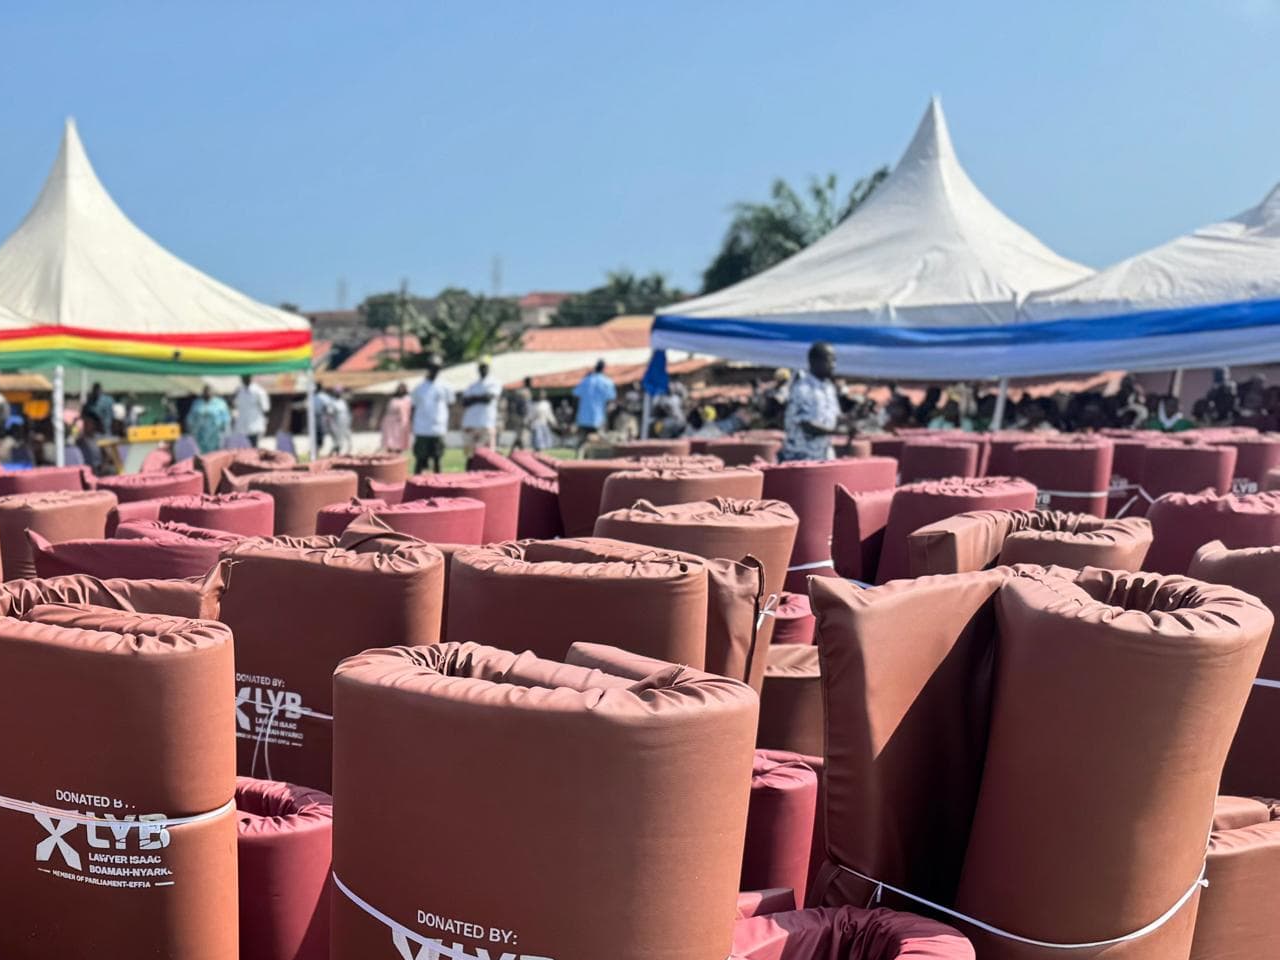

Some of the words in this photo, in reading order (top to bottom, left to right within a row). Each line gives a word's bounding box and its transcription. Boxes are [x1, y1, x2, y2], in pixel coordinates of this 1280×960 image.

[255, 687, 302, 719] LYB
[56, 789, 110, 808] DONATED
[86, 811, 171, 850] LYB
[88, 852, 128, 864] LAWYER
[129, 854, 161, 864] ISAAC
[52, 870, 75, 881] MEMBER
[85, 877, 151, 889] PARLIAMENT-EFFIA
[417, 909, 484, 939] DONATED
[489, 927, 518, 945] BY:
